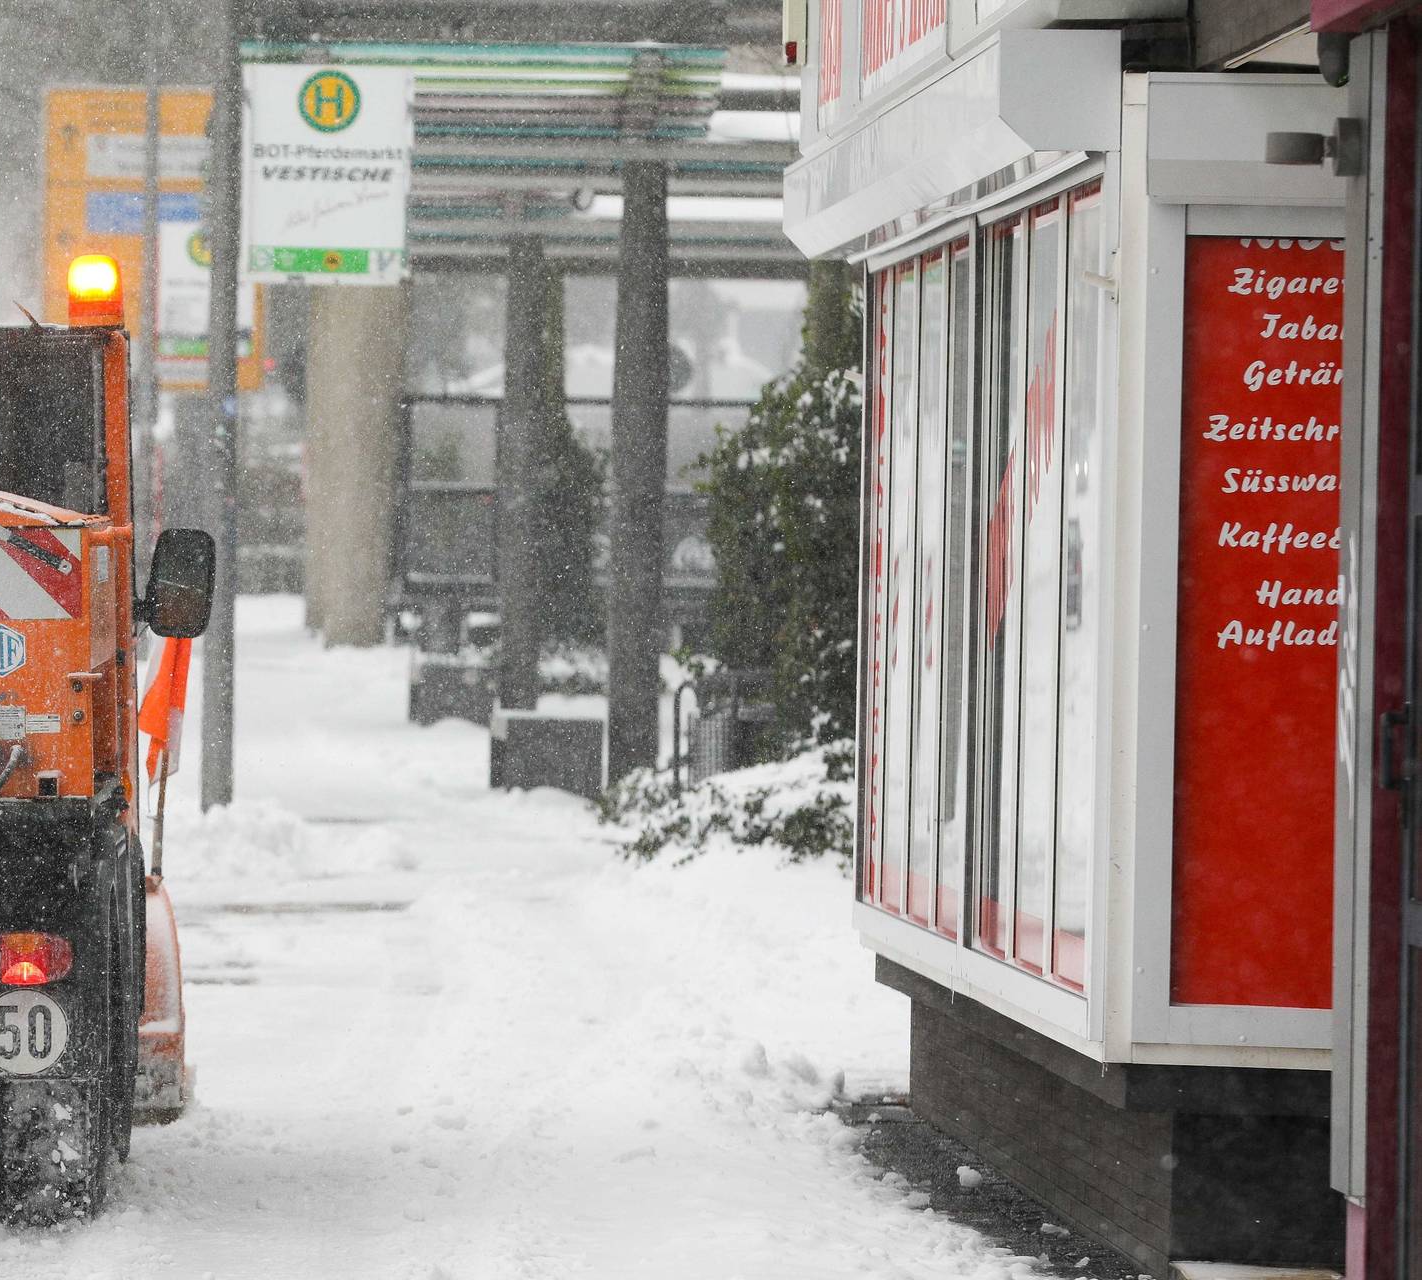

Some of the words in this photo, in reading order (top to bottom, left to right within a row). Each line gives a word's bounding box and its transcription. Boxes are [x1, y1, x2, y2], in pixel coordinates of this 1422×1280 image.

[253, 143, 403, 160] BOT-Pferdemarkt
[262, 165, 394, 182] VESTISCHE
[1228, 267, 1345, 300] Zigare
[1260, 313, 1345, 341] Taba
[1203, 414, 1341, 442] Zeitschr
[1221, 467, 1341, 494] Süsswa
